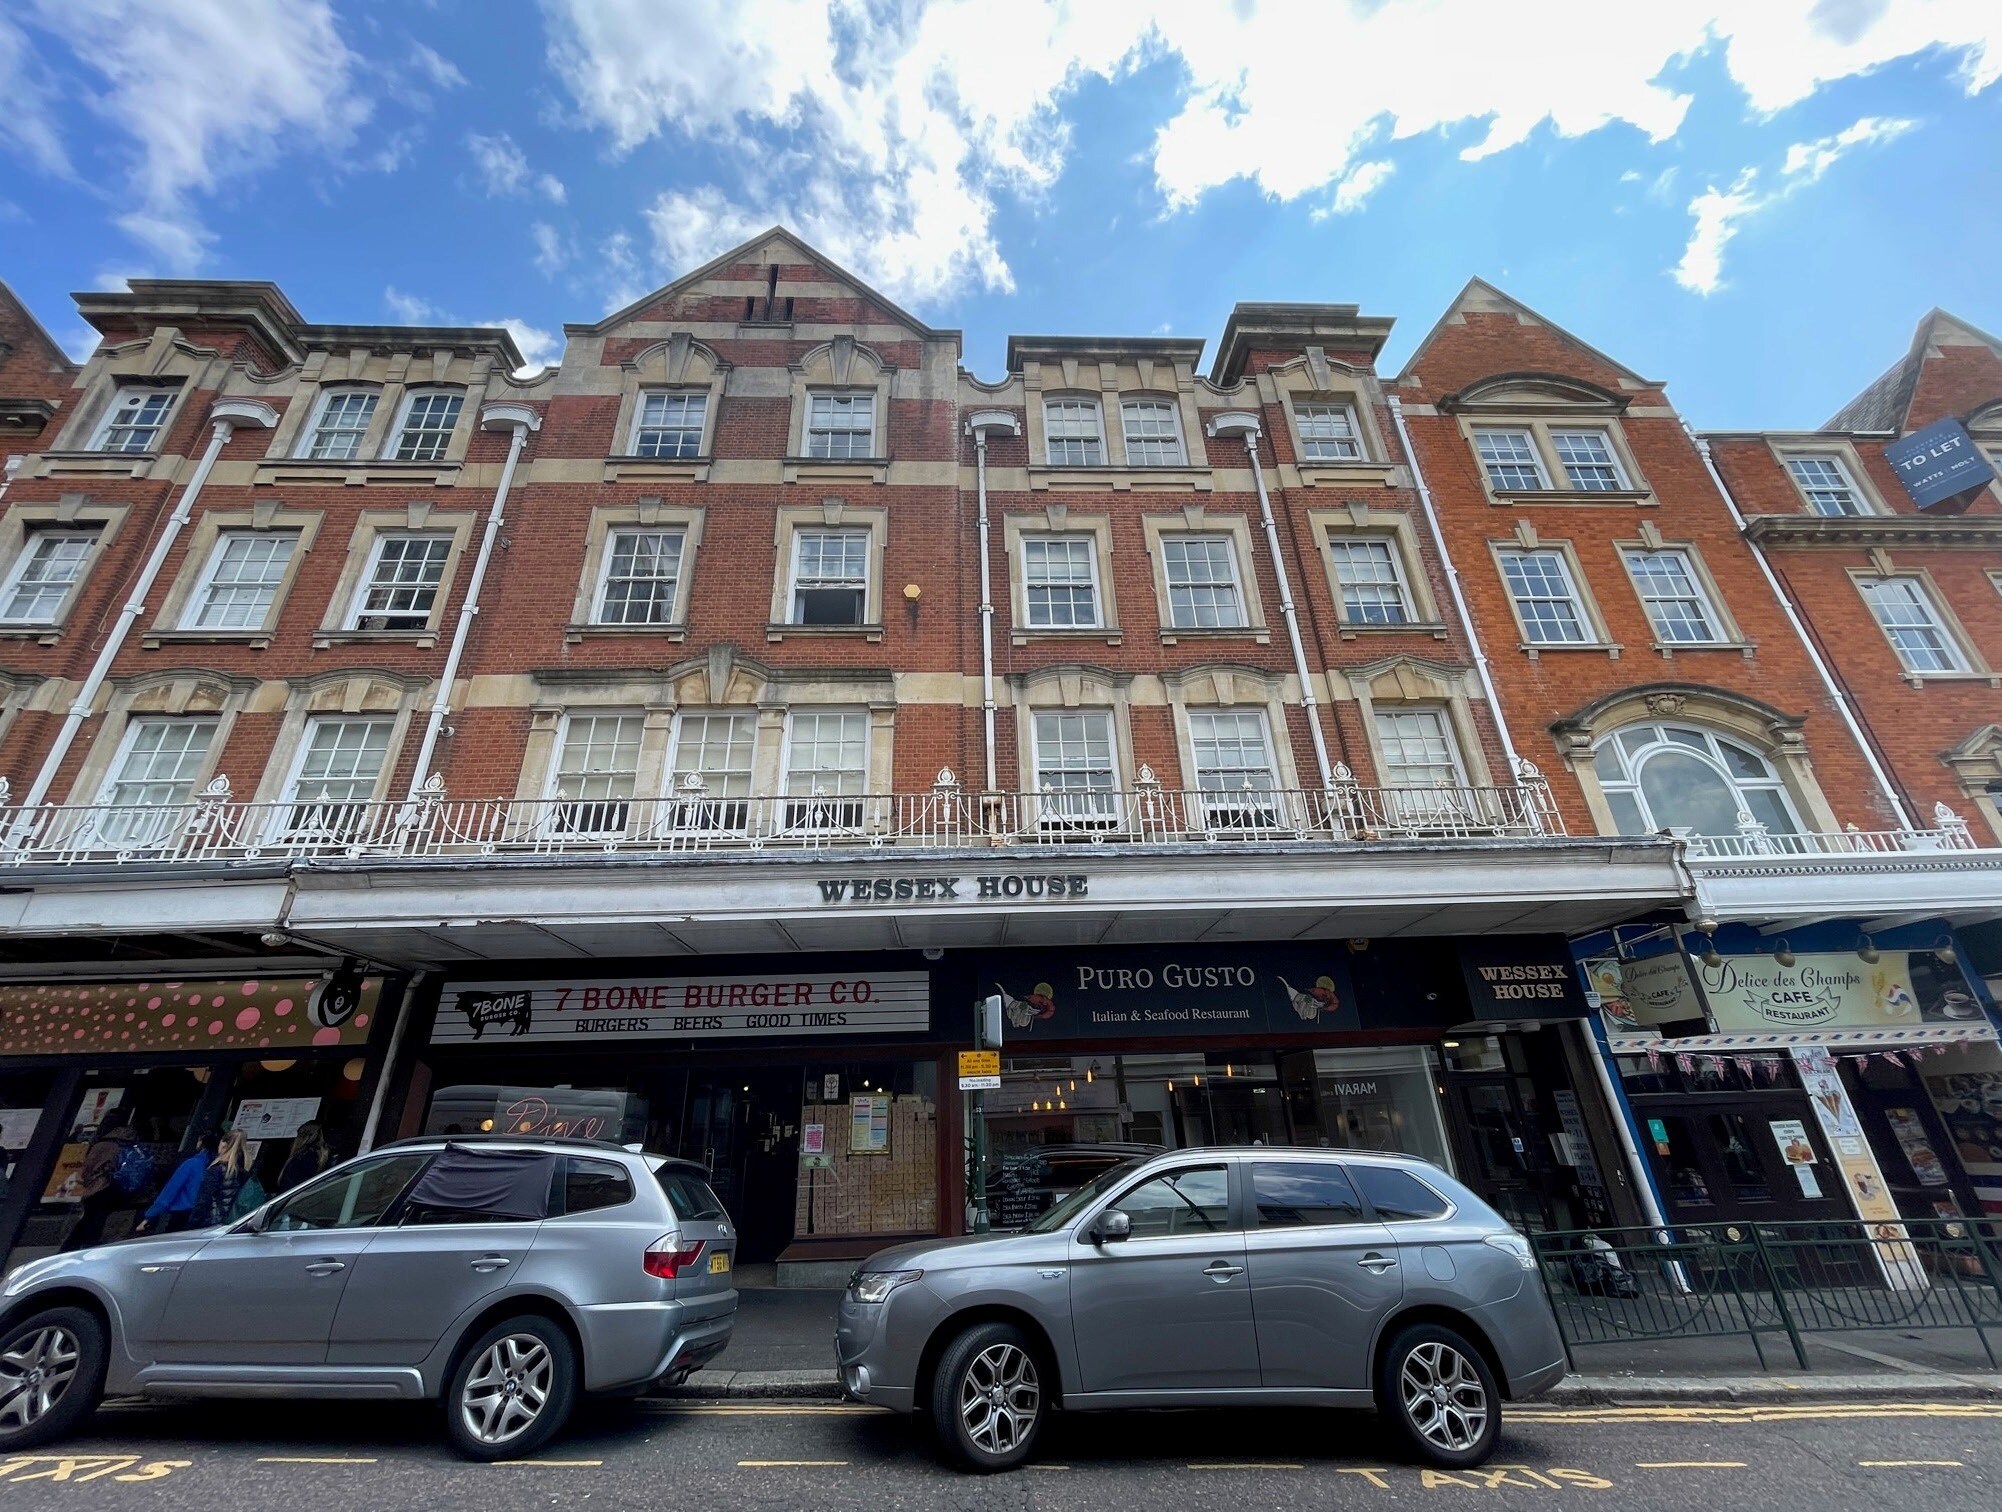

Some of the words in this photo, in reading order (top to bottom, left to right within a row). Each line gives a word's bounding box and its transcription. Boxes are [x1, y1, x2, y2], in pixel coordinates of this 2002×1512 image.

[1900, 455, 1927, 470] TO
[1930, 436, 1961, 457] LET
[1913, 471, 1944, 488] WATTS
[818, 877, 960, 901] WESSEX
[977, 875, 1088, 897] HOUSE
[1076, 966, 1154, 990] PURO
[1162, 964, 1256, 988] GUSTO
[1478, 965, 1568, 981] WESSEX
[1702, 959, 1769, 994] Delice
[1774, 971, 1796, 987] des
[1800, 967, 1861, 990] Champs
[555, 988, 572, 1011] 7
[582, 986, 669, 1011] BONE
[684, 982, 813, 1009] BURGER
[829, 980, 880, 1004] CO.
[1492, 983, 1565, 1000] HOUSE
[1651, 990, 1670, 998] CAFE
[1771, 992, 1813, 1004] CAFE
[472, 994, 525, 1018] 7BONE
[1092, 1010, 1127, 1022] Italian
[1130, 1010, 1142, 1021] &
[1144, 1008, 1189, 1021] Seafood
[1192, 1008, 1250, 1020] Restaurant
[1765, 1006, 1830, 1020] RESTAURANT
[575, 1018, 649, 1032] BURGERS
[673, 1016, 723, 1030] BEERS
[746, 1013, 791, 1028] GOOD
[801, 1012, 847, 1026] TIMES
[1336, 1467, 1614, 1490] TAXIS
